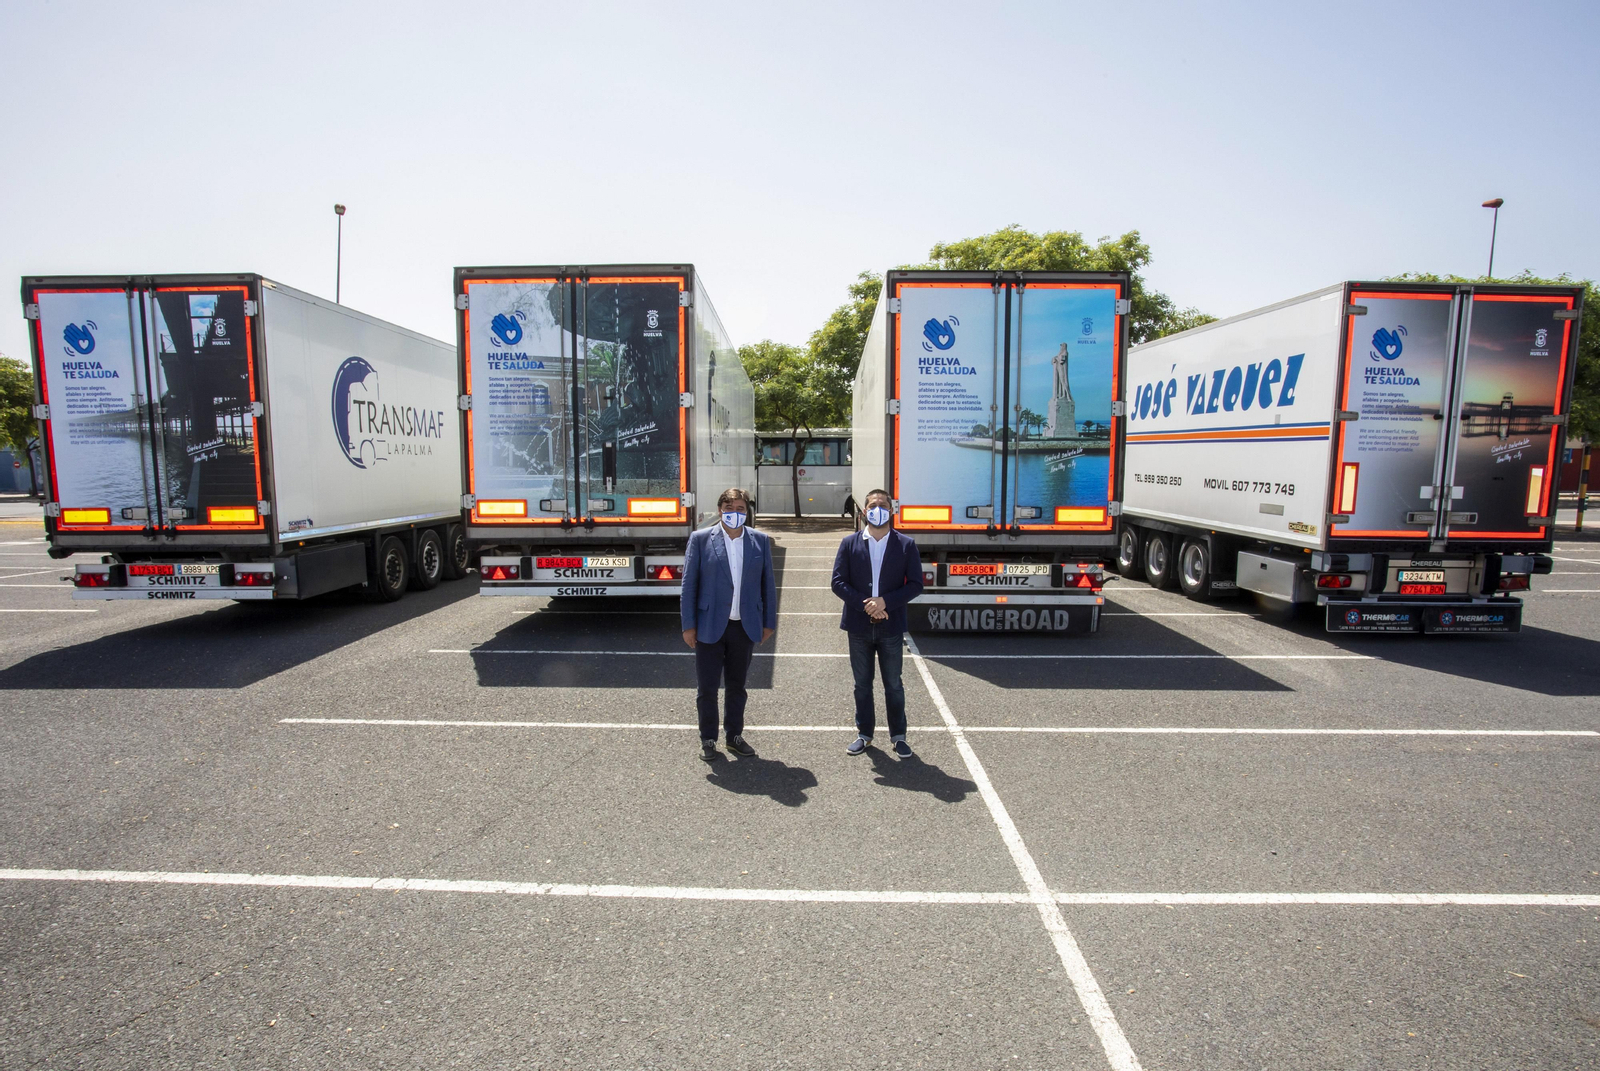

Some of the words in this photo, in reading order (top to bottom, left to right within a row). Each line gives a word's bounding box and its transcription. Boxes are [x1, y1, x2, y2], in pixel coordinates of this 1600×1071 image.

[488, 352, 528, 360] HUELVA
[62, 361, 103, 370] HUELVA
[488, 362, 501, 370] TE
[502, 361, 544, 370] SALUDA
[918, 358, 960, 366] HUELVA
[63, 370, 76, 379] TE
[78, 370, 120, 379] SALUDA
[918, 366, 932, 374] TE
[934, 366, 976, 375] SALUDA
[1365, 367, 1405, 376] HUELVA
[1364, 376, 1377, 384] TE
[1379, 376, 1420, 385] SALUDA
[353, 399, 444, 438] TRANSMAF
[1134, 474, 1142, 482] TEL
[1144, 474, 1155, 483] 959
[1156, 475, 1168, 485] 350
[1170, 476, 1182, 486] 250
[1204, 478, 1228, 490] MOVIL
[1232, 480, 1249, 492] 607
[1253, 482, 1270, 494] 773
[1274, 483, 1294, 496] 749
[184, 566, 202, 574] 9989
[554, 569, 614, 578] SCHMITZ
[1008, 566, 1030, 574] 0725
[148, 576, 206, 586] SCHMITZ
[968, 576, 1029, 585] SCHMITZ
[940, 609, 995, 630] KING
[1004, 609, 1069, 630] ROAD
